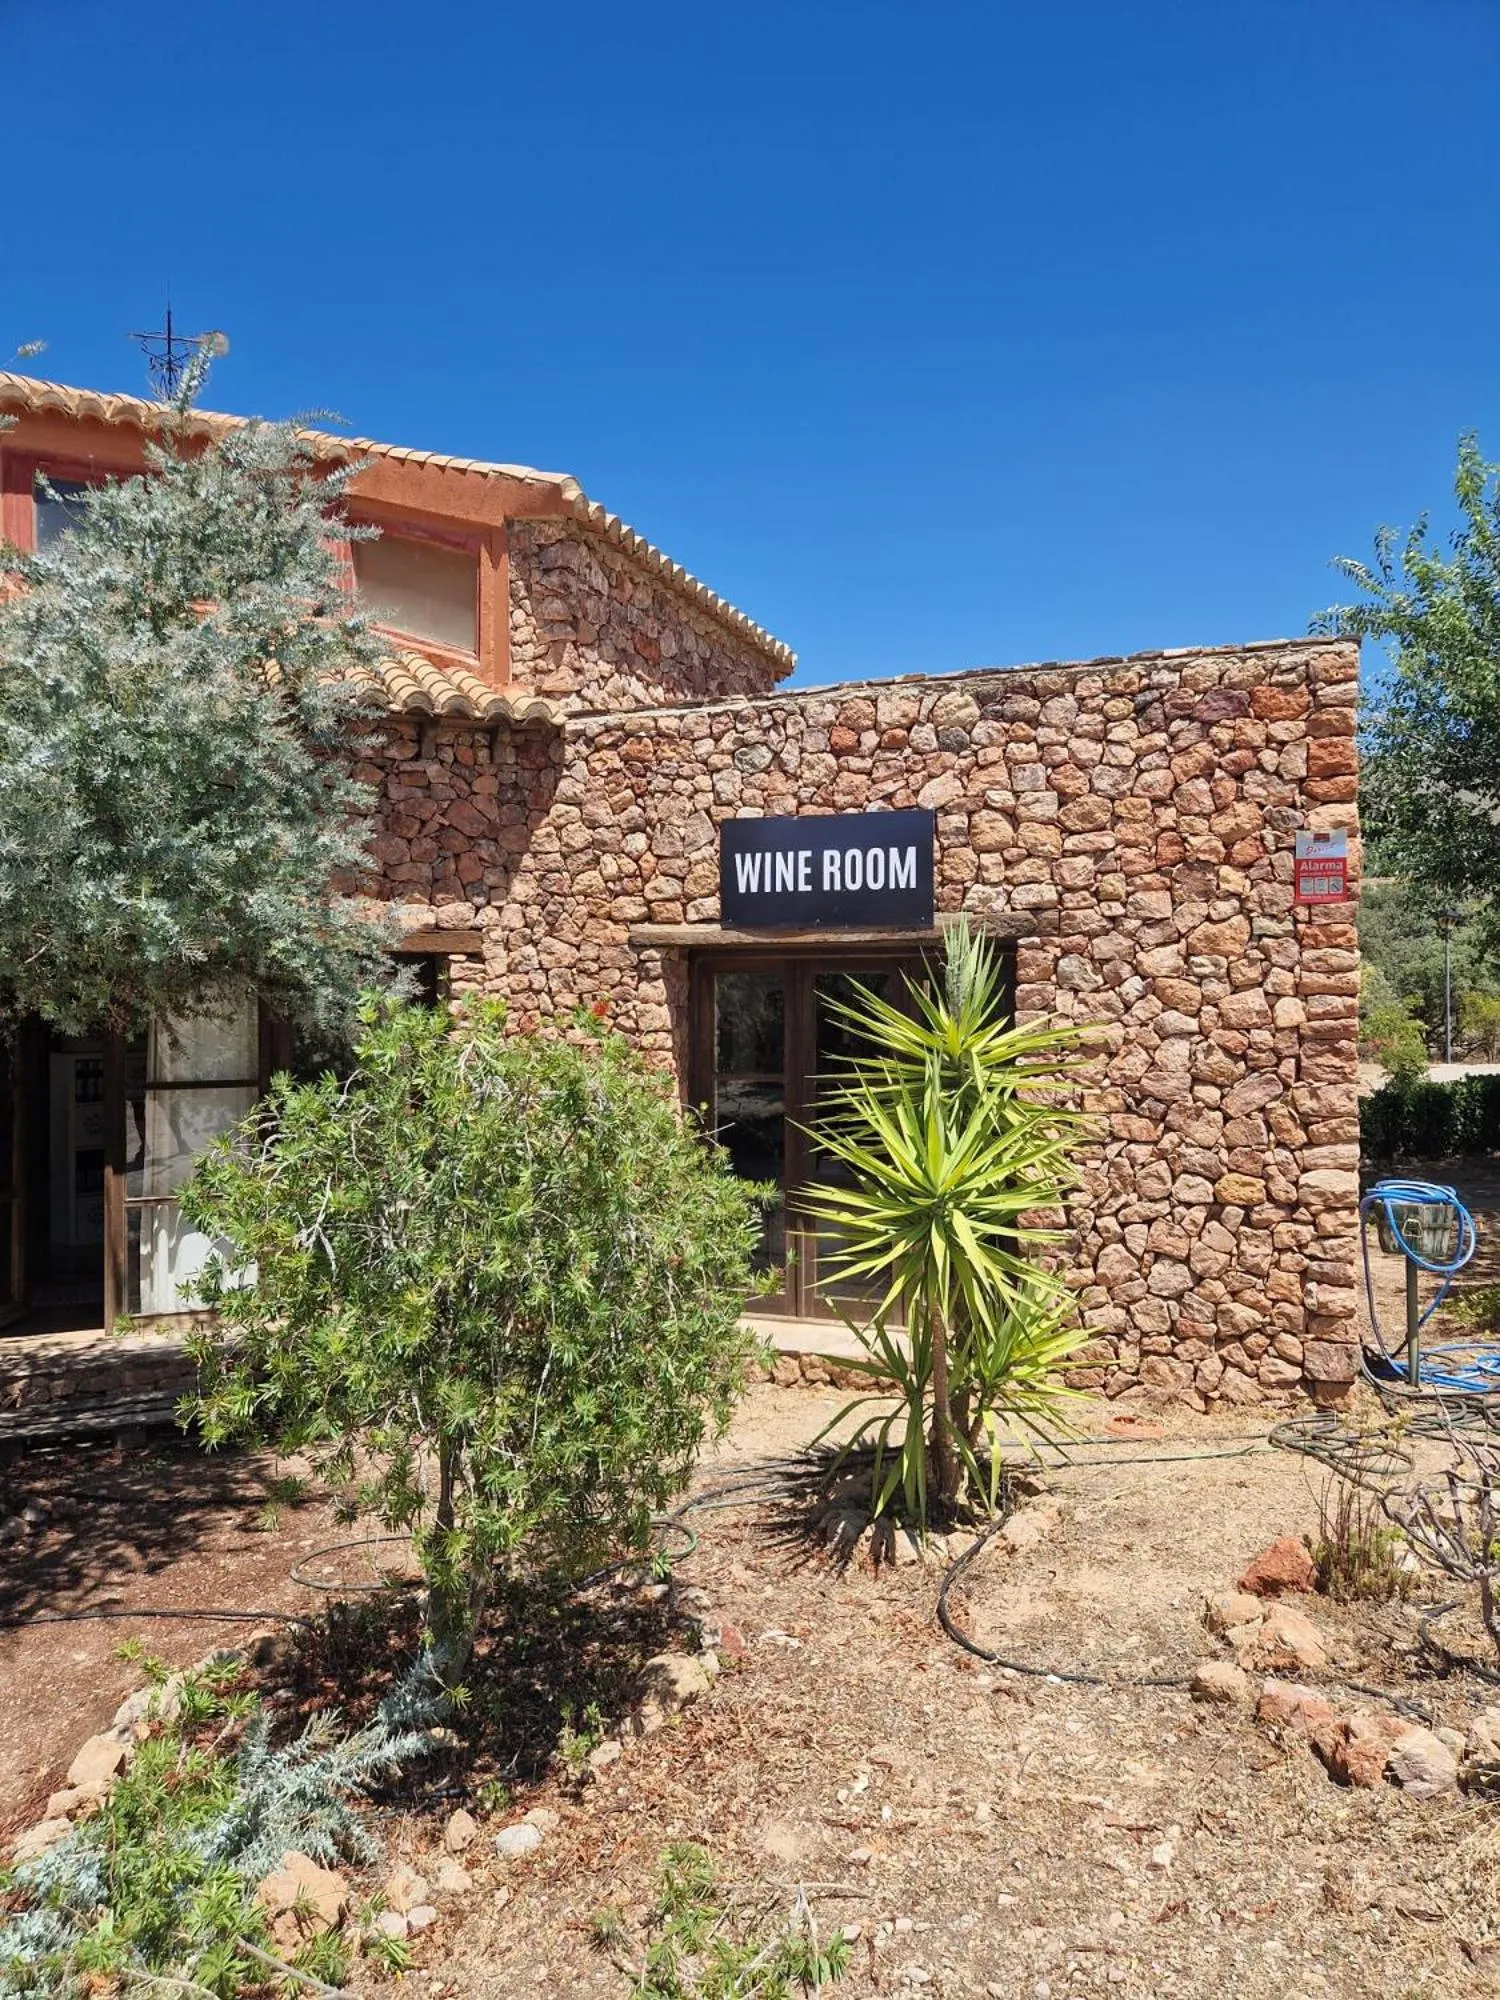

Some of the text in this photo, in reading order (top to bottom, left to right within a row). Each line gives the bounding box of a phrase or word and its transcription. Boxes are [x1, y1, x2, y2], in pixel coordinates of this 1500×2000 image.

[735, 846, 917, 893] WINE ROOM
[1300, 860, 1343, 871] Alarma
